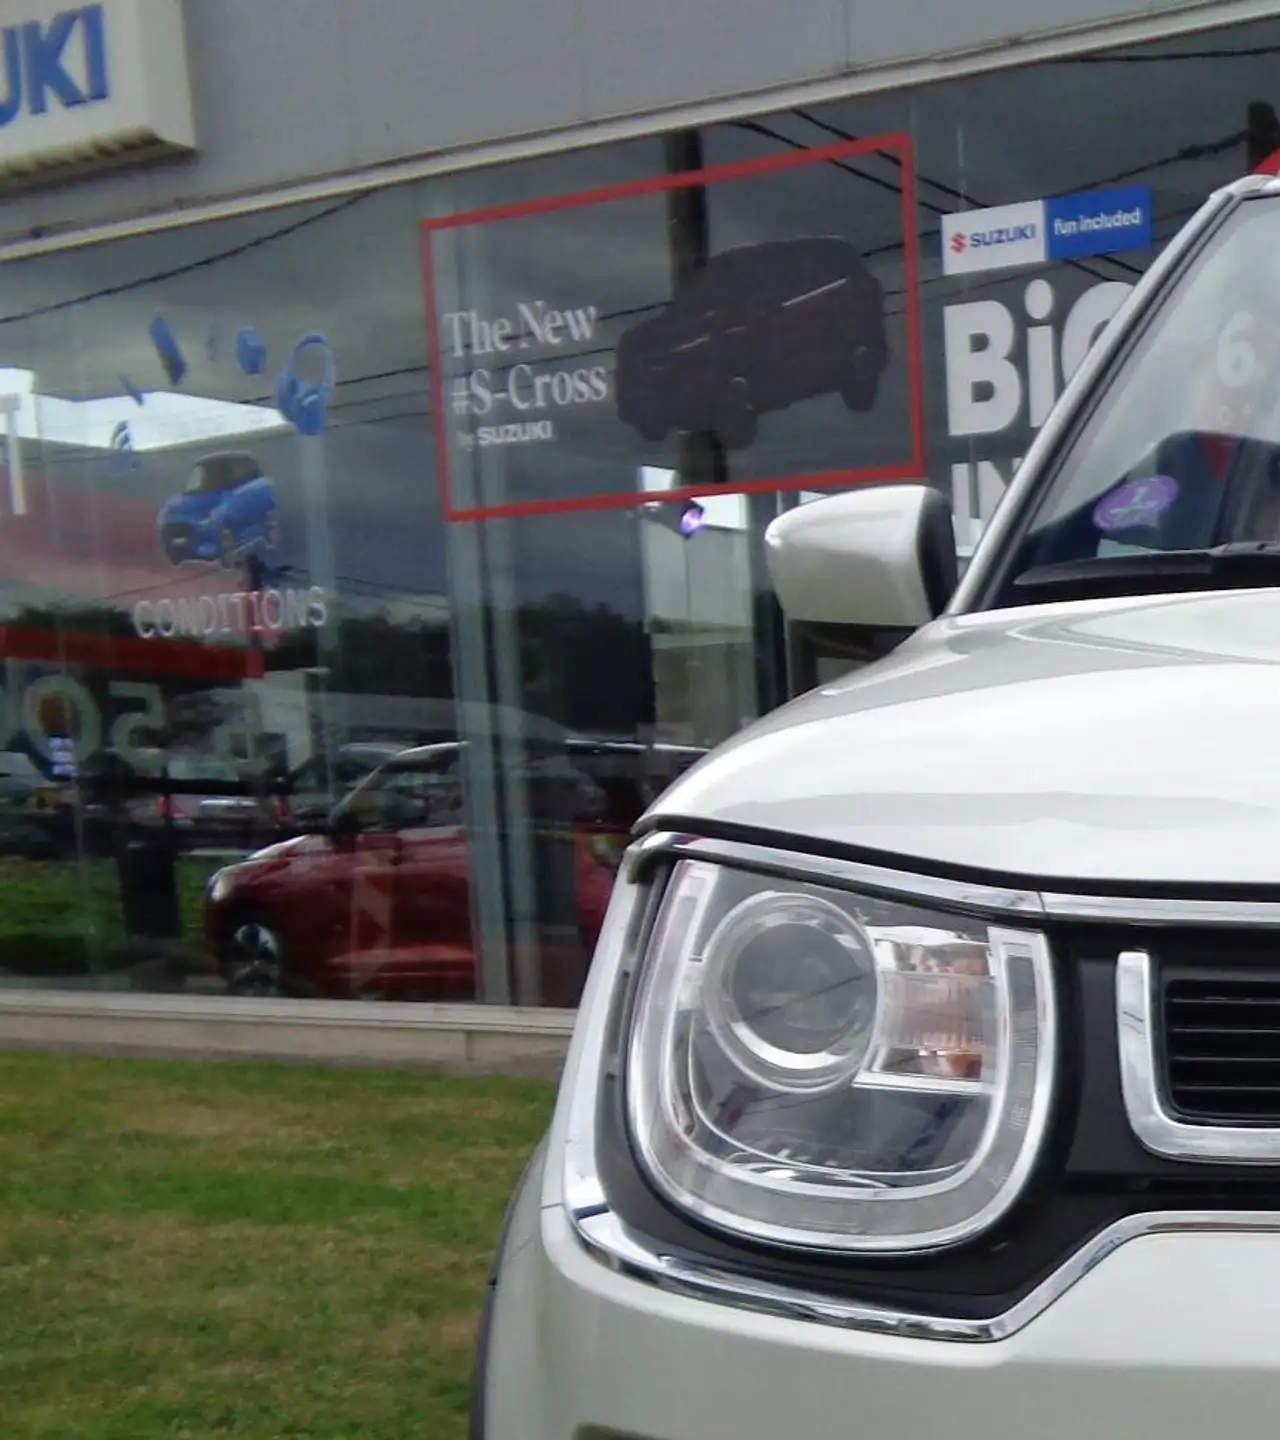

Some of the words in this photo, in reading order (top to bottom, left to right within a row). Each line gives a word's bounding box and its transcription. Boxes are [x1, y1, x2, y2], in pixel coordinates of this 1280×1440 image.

[969, 223, 1036, 248] SUZUKI
[1054, 216, 1076, 237] fun
[1079, 206, 1142, 233] included
[444, 309, 512, 357] The
[516, 299, 598, 345] New
[451, 363, 608, 416] #S-Cross
[477, 419, 553, 447] SUZUKI
[132, 585, 328, 639] CONDITIONS
